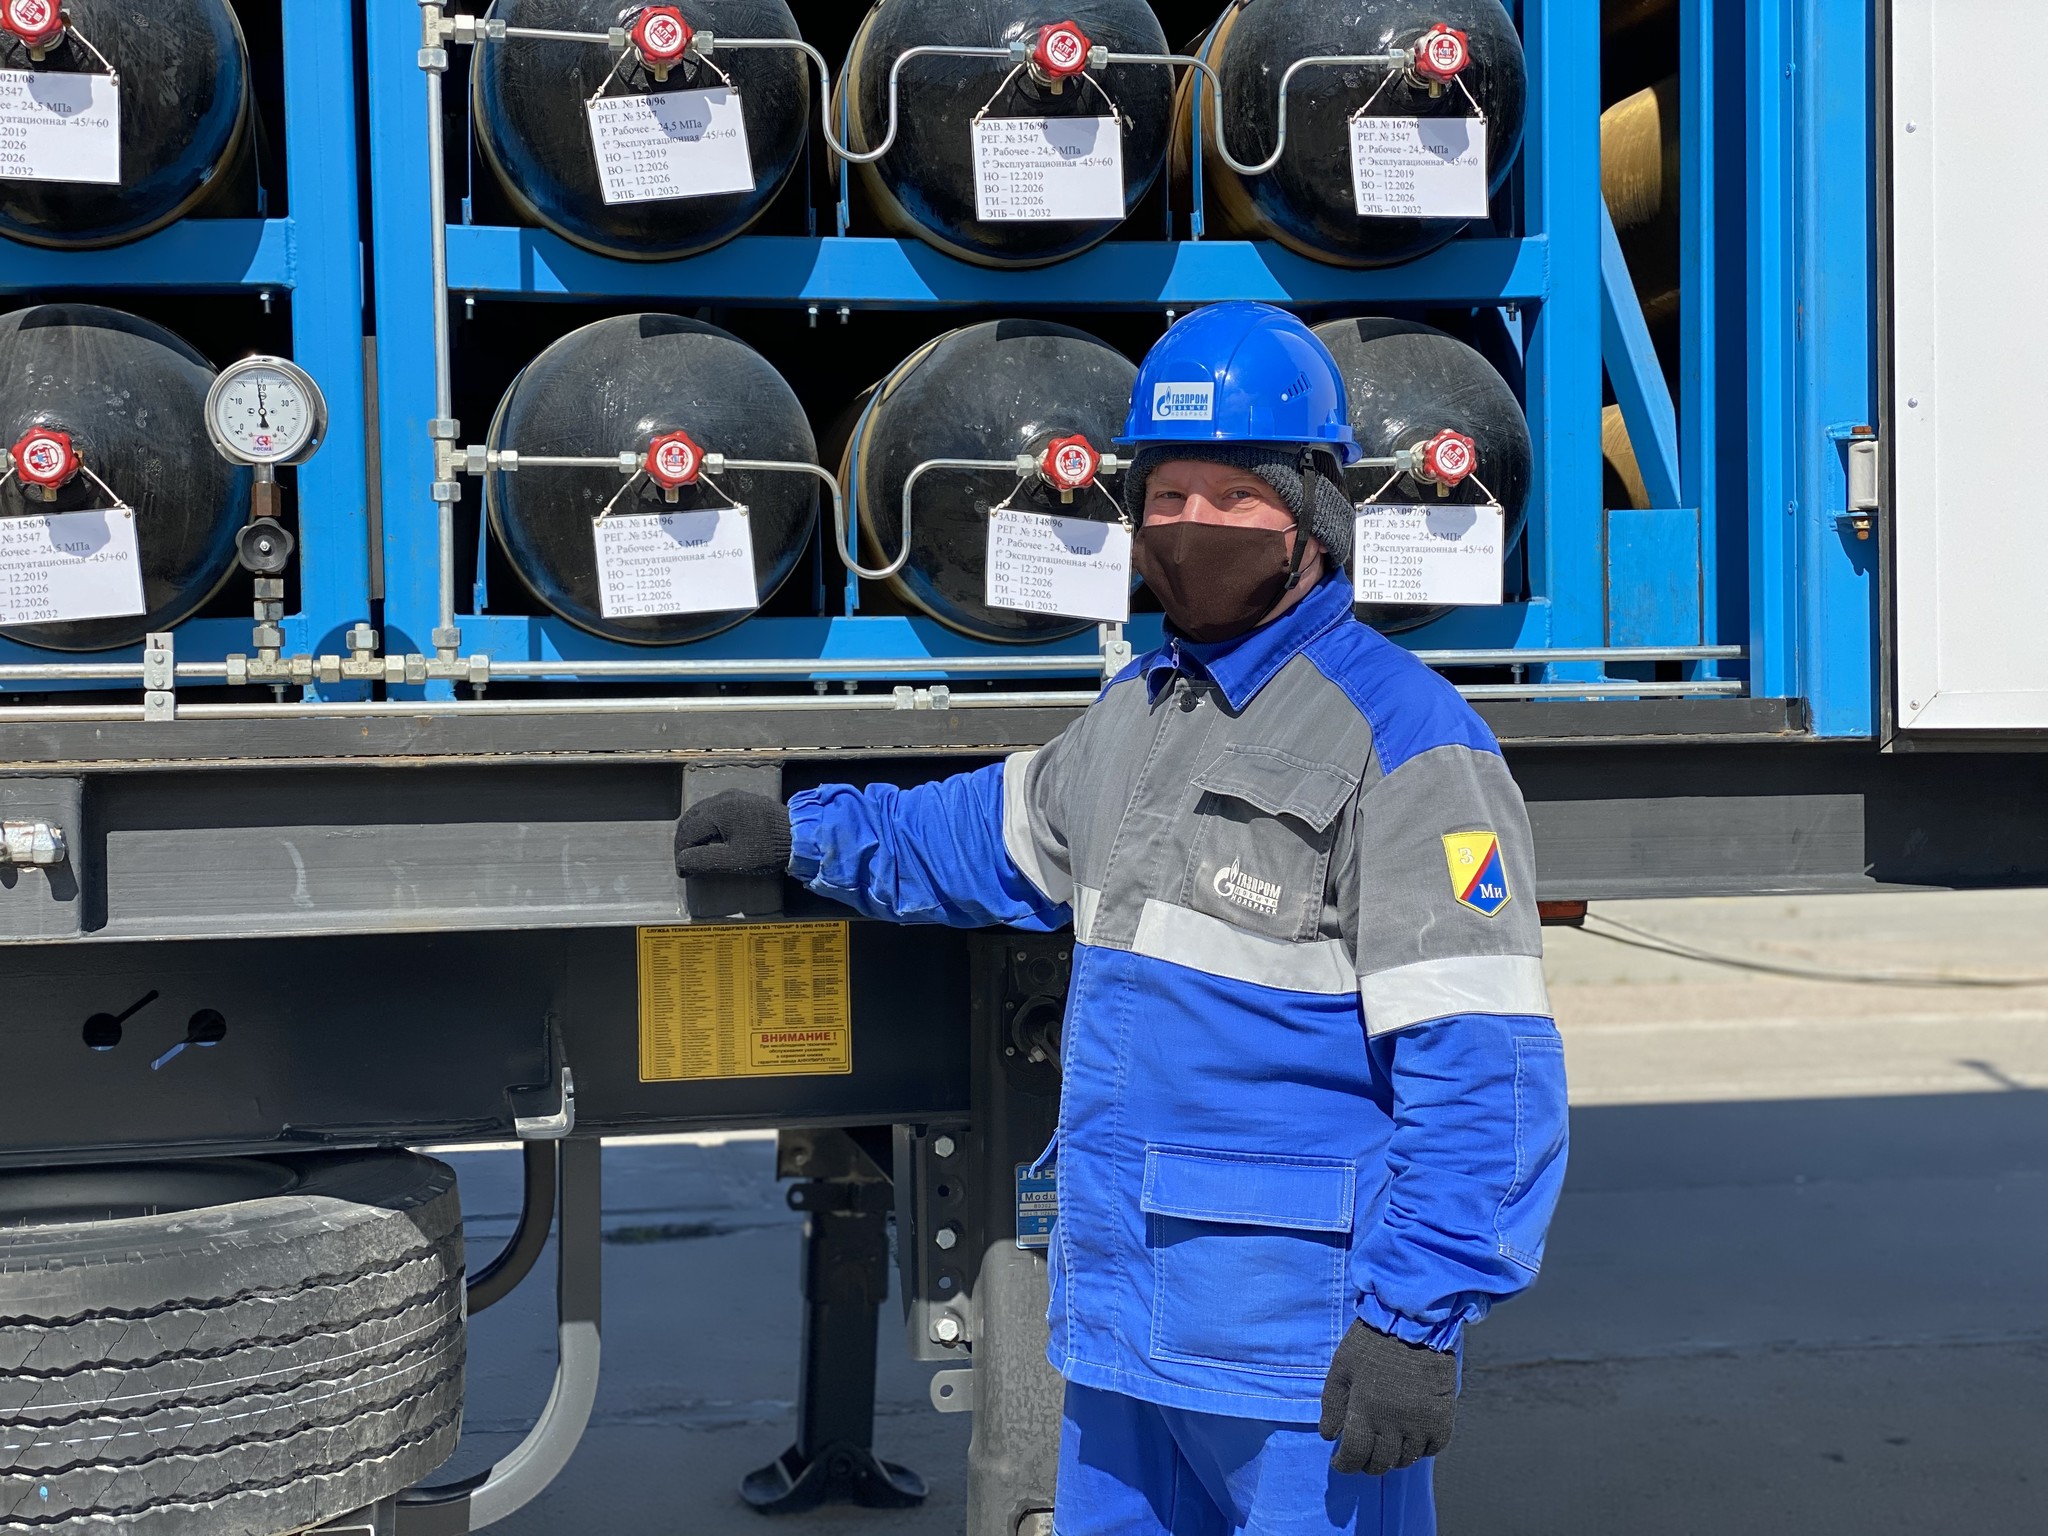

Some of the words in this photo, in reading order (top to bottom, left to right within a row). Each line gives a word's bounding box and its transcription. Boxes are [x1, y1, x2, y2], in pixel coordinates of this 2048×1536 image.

[1058, 42, 1072, 54] КПГ
[22, 101, 42, 112] 24,5
[47, 102, 72, 113] МПа
[596, 101, 619, 111] ЗАВ.
[636, 97, 665, 107] 150/96
[598, 114, 620, 124] РЕГ.
[635, 110, 657, 120] 3547
[612, 124, 649, 135] Рабочее
[657, 121, 677, 132] 24,5
[679, 119, 702, 129] МПа
[981, 122, 1002, 130] ЗАВ.
[1020, 122, 1048, 130] 176/96
[1357, 120, 1377, 128] ЗАВ.
[1393, 120, 1419, 129] 167/96
[613, 135, 699, 149] Эксплуатационная
[701, 128, 736, 139] -45/+60
[982, 135, 1002, 143] РЕГ.
[1018, 134, 1038, 143] 3547
[1358, 132, 1376, 141] РЕГ.
[1391, 132, 1410, 141] 3547
[605, 152, 622, 162] НО
[632, 148, 667, 159] 12.2019
[994, 147, 1029, 155] Рабочее
[1037, 146, 1056, 156] 24,5
[1059, 146, 1080, 154] МПа
[1369, 145, 1402, 153] Рабочее
[1409, 145, 1426, 154] 24,5
[1429, 145, 1448, 153] МПа
[608, 165, 624, 174] ВО
[634, 161, 669, 172] 12.2026
[992, 159, 1076, 170] Эксплуатационная
[1080, 158, 1113, 166] -45/+60
[1368, 156, 1445, 167] Эксплуатационная
[1448, 157, 1478, 165] -45/+60
[984, 172, 999, 180] НО
[1010, 172, 1043, 180] 12.2019
[1361, 169, 1374, 177] НО
[1385, 170, 1415, 178] 12.2019
[610, 178, 625, 187] ГИ
[636, 174, 670, 185] 12.2026
[1385, 182, 1415, 190] 12.2026
[612, 190, 634, 200] ЭПБ
[644, 186, 679, 197] 01.2032
[985, 185, 999, 193] ВО
[1010, 184, 1043, 192] 12.2026
[986, 197, 999, 205] ГИ
[1010, 197, 1043, 205] 12.2026
[1385, 193, 1415, 202] 12.2026
[986, 209, 1007, 217] ЭПБ
[1017, 209, 1050, 217] 01.2032
[1364, 205, 1382, 213] ЭПБ
[1391, 205, 1421, 214] 01.2032
[1172, 394, 1208, 404] ГАЗПРОМ
[1364, 508, 1386, 516] ЗАВ.
[1402, 508, 1431, 517] 097/96
[18, 519, 50, 529] 156/96
[603, 520, 626, 529] ЗАВ.
[643, 517, 673, 527] 143/96
[998, 512, 1020, 523] ЗАВ.
[1036, 517, 1063, 528] 148/96
[1364, 520, 1384, 528] РЕГ.
[1400, 520, 1421, 528] 3547
[16, 532, 40, 543] 3547
[604, 532, 625, 542] РЕГ.
[642, 529, 664, 539] 3547
[998, 524, 1018, 535] РЕГ.
[1032, 528, 1053, 539] 3547
[1375, 532, 1410, 540] Рабочее
[1418, 532, 1437, 541] 24,5
[1440, 532, 1462, 541] МПа
[40, 545, 61, 555] 24,5
[65, 542, 90, 551] МПа
[617, 543, 654, 553] Рабочее
[663, 540, 683, 550] 24,5
[685, 539, 708, 548] МПа
[1008, 538, 1043, 550] Рабочее
[1050, 542, 1069, 553] 24,5
[1071, 544, 1092, 555] МПа
[1372, 544, 1457, 555] Эксплуатационная
[1460, 544, 1494, 553] -45/+60
[89, 552, 128, 562] -45/+60
[617, 554, 705, 566] Эксплуатационная
[707, 548, 742, 558] -45/+60
[1006, 550, 1087, 568] Эксплуатационная
[1089, 558, 1122, 570] -45/+60
[1363, 555, 1379, 563] НО
[1390, 556, 1423, 564] 12.2019
[608, 569, 624, 578] НО
[636, 566, 670, 576] 12.2019
[996, 561, 1011, 570] НО
[1022, 564, 1054, 575] 12.2019
[1389, 568, 1422, 576] 12.2026
[9, 571, 48, 583] 12.2019
[996, 573, 1011, 582] ВО
[1021, 576, 1053, 587] 12.2026
[9, 584, 49, 596] 12.2026
[609, 582, 625, 590] ВО
[636, 578, 671, 588] 12.2026
[1388, 580, 1421, 588] 12.2026
[610, 594, 625, 602] ГИ
[637, 591, 672, 601] 12.2026
[995, 585, 1009, 594] ГИ
[1020, 588, 1052, 599] 12.2026
[1362, 591, 1384, 600] ЭПБ
[1393, 592, 1428, 601] 01.2032
[10, 597, 49, 609] 12.2026
[612, 606, 634, 615] ЭПБ
[644, 602, 680, 613] 01.2032
[995, 597, 1016, 607] ЭПБ
[1025, 600, 1058, 612] 01.2032
[18, 610, 58, 621] 01.2032
[1236, 872, 1282, 899] ГАЗПРОМ
[1479, 884, 1503, 898] Ми
[1235, 887, 1277, 906] ДОБЫЧА
[1230, 894, 1277, 914] НОЯБРЬСК
[761, 1032, 830, 1043] ВНИМАНИЕ
